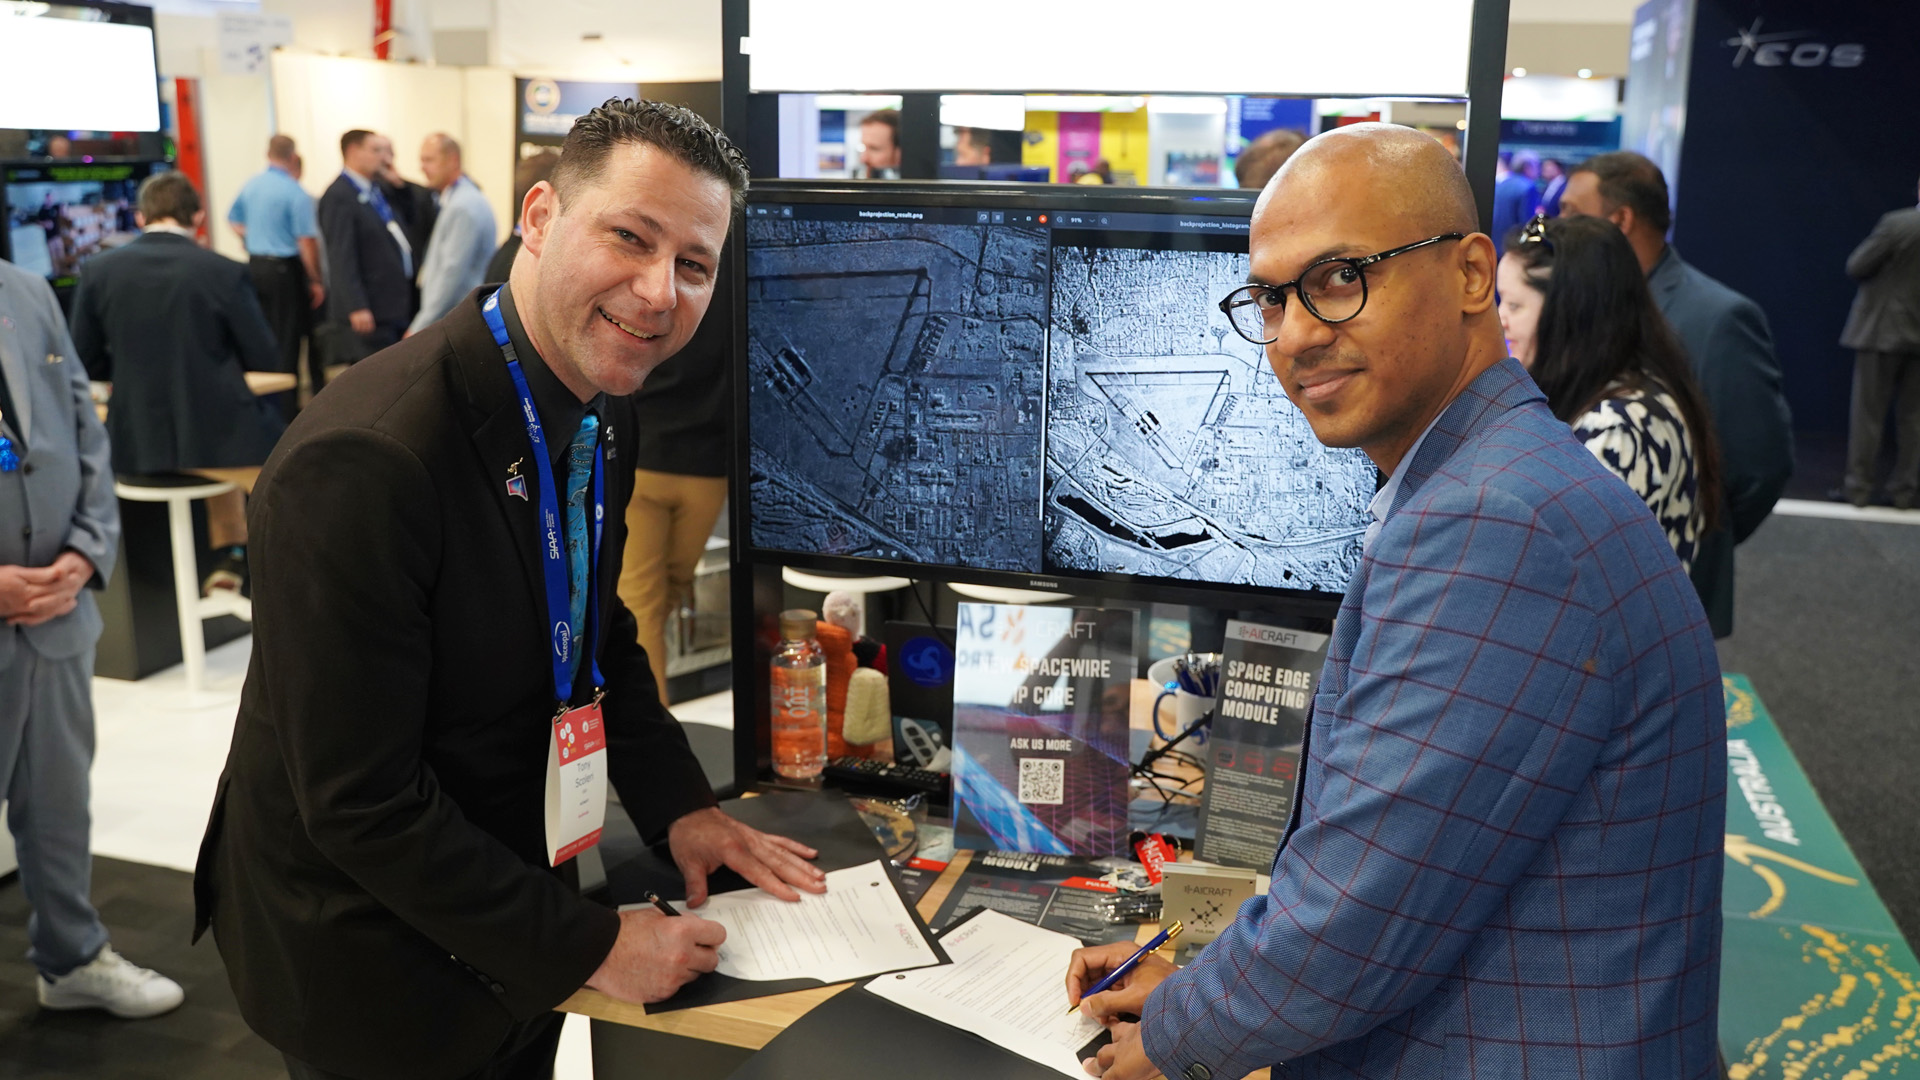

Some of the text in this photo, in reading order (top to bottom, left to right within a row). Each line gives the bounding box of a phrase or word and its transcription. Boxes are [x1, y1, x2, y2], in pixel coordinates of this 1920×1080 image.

[1179, 220, 1250, 230] backprojection_histogram.
[1030, 580, 1059, 589] SAMSUNG
[1249, 628, 1299, 646] AICRAFT
[1018, 657, 1112, 679] SPACEWIRE
[1227, 660, 1311, 690] SPACE EDGE
[1012, 686, 1075, 706] IP CORE
[1224, 679, 1306, 710] COMPUTING
[1221, 698, 1279, 726] MODULE
[1010, 737, 1072, 752] ASK US MORE
[981, 855, 1040, 873] MODULE
[1193, 886, 1233, 896] AICRAFT
